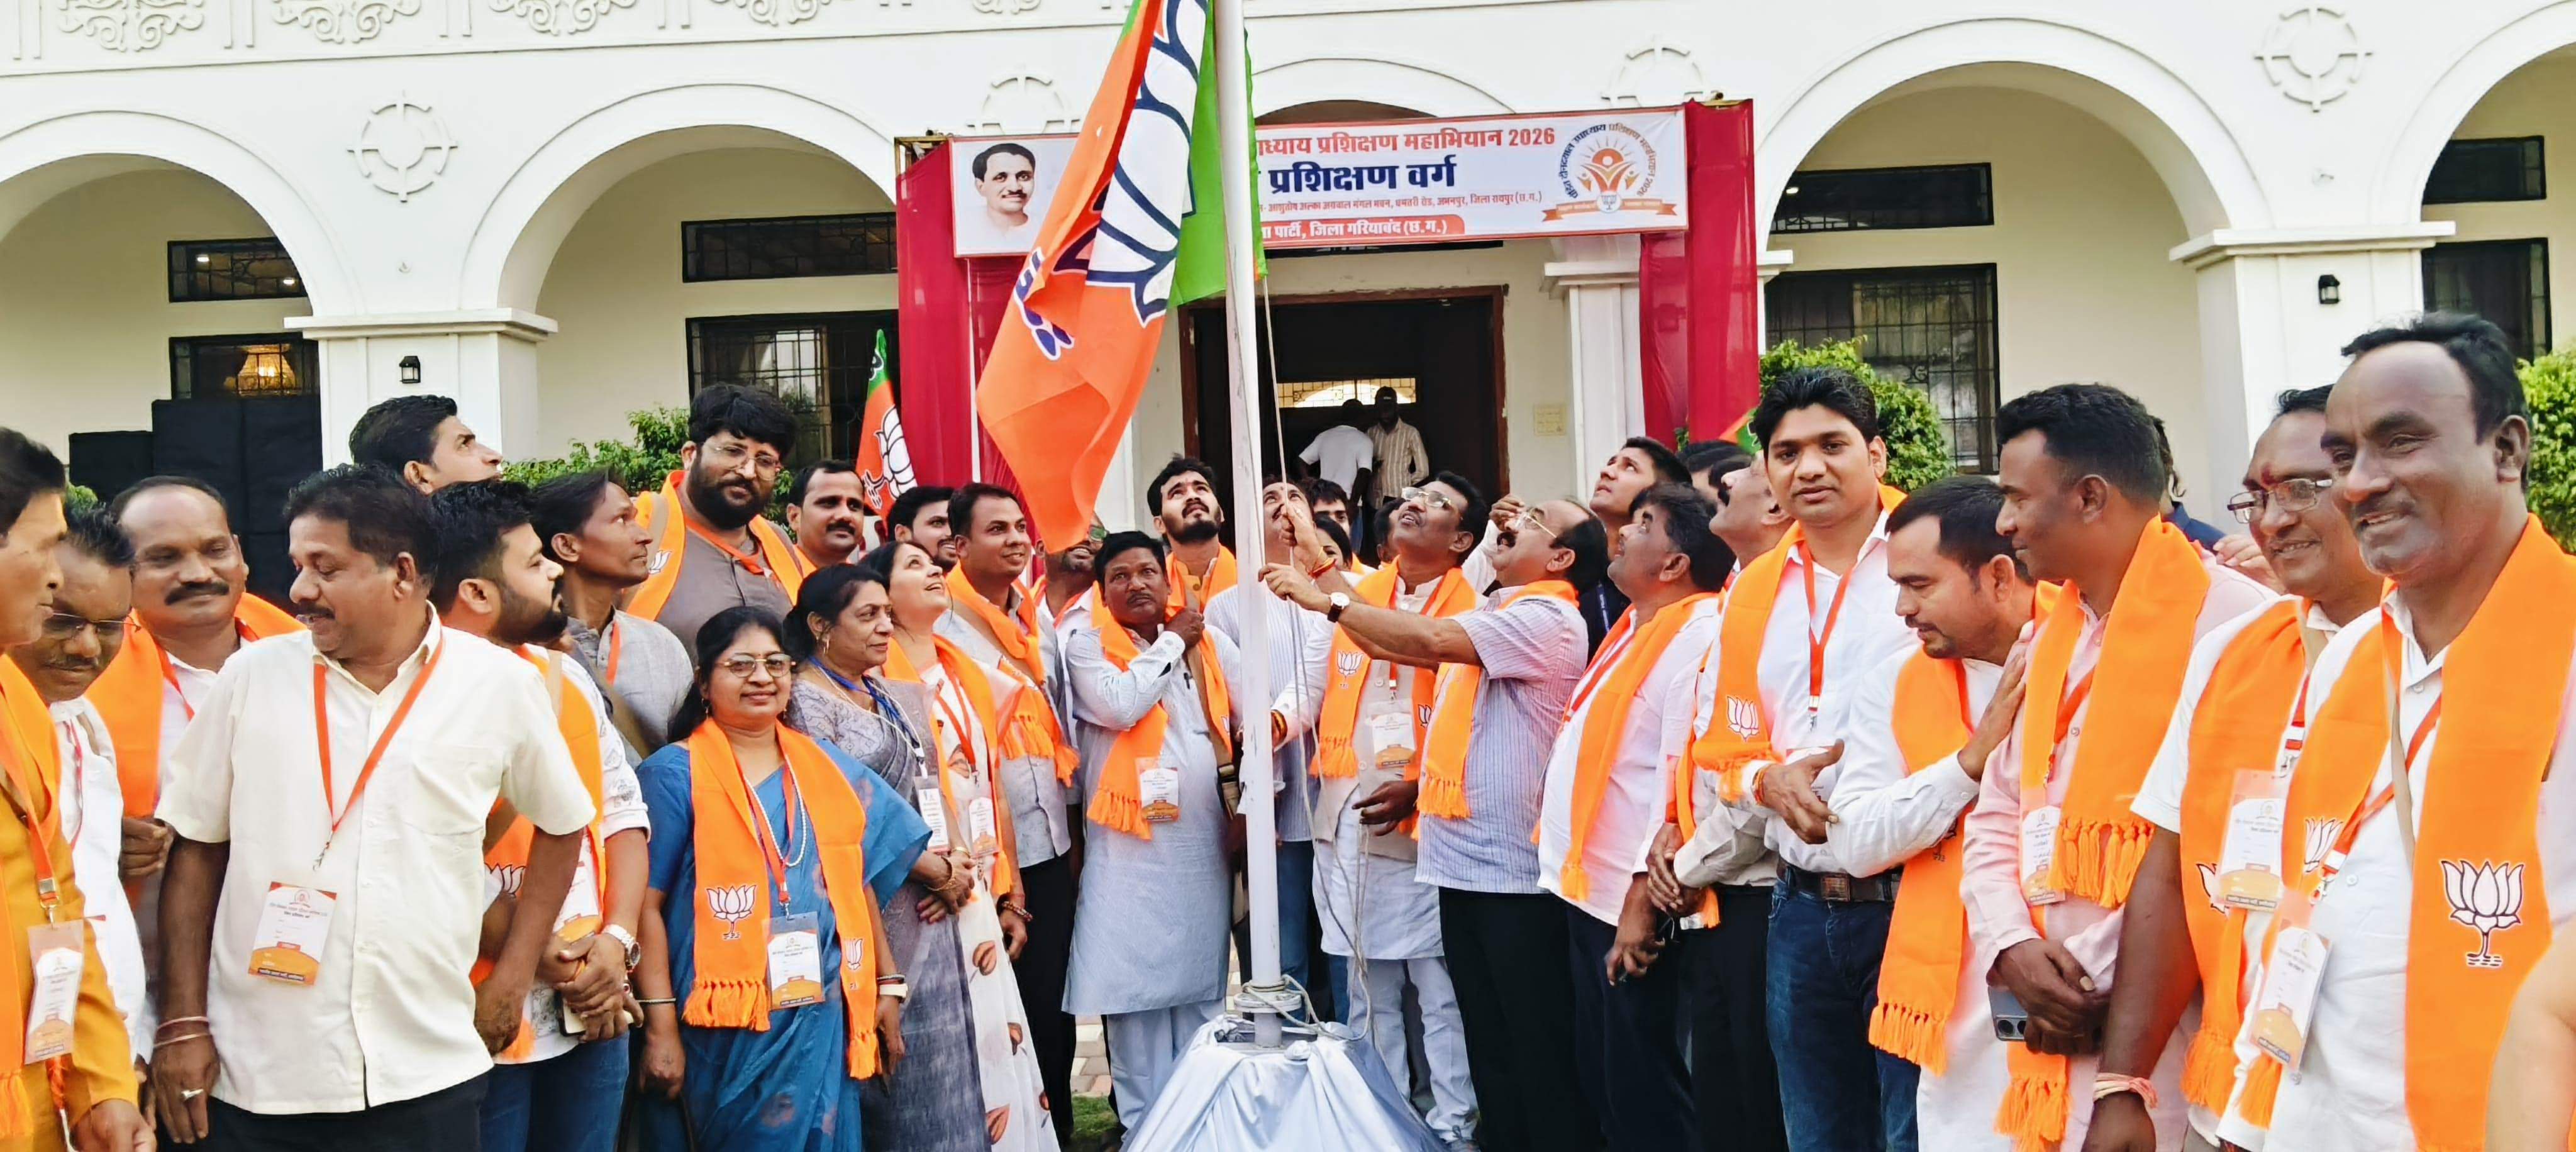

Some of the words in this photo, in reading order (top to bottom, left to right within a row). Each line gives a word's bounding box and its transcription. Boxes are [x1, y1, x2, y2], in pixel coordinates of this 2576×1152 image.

[1257, 137, 1313, 156] ाध्याय
[1316, 131, 1399, 155] प्रशिक्षण
[1404, 128, 1504, 150] महाभियान
[1508, 128, 1555, 147] 2026
[1268, 161, 1399, 194] प्रशिक्षण
[1406, 154, 1457, 187] वर्ग
[1309, 220, 1345, 238] जिला
[1346, 218, 1402, 236] गरियाबंद
